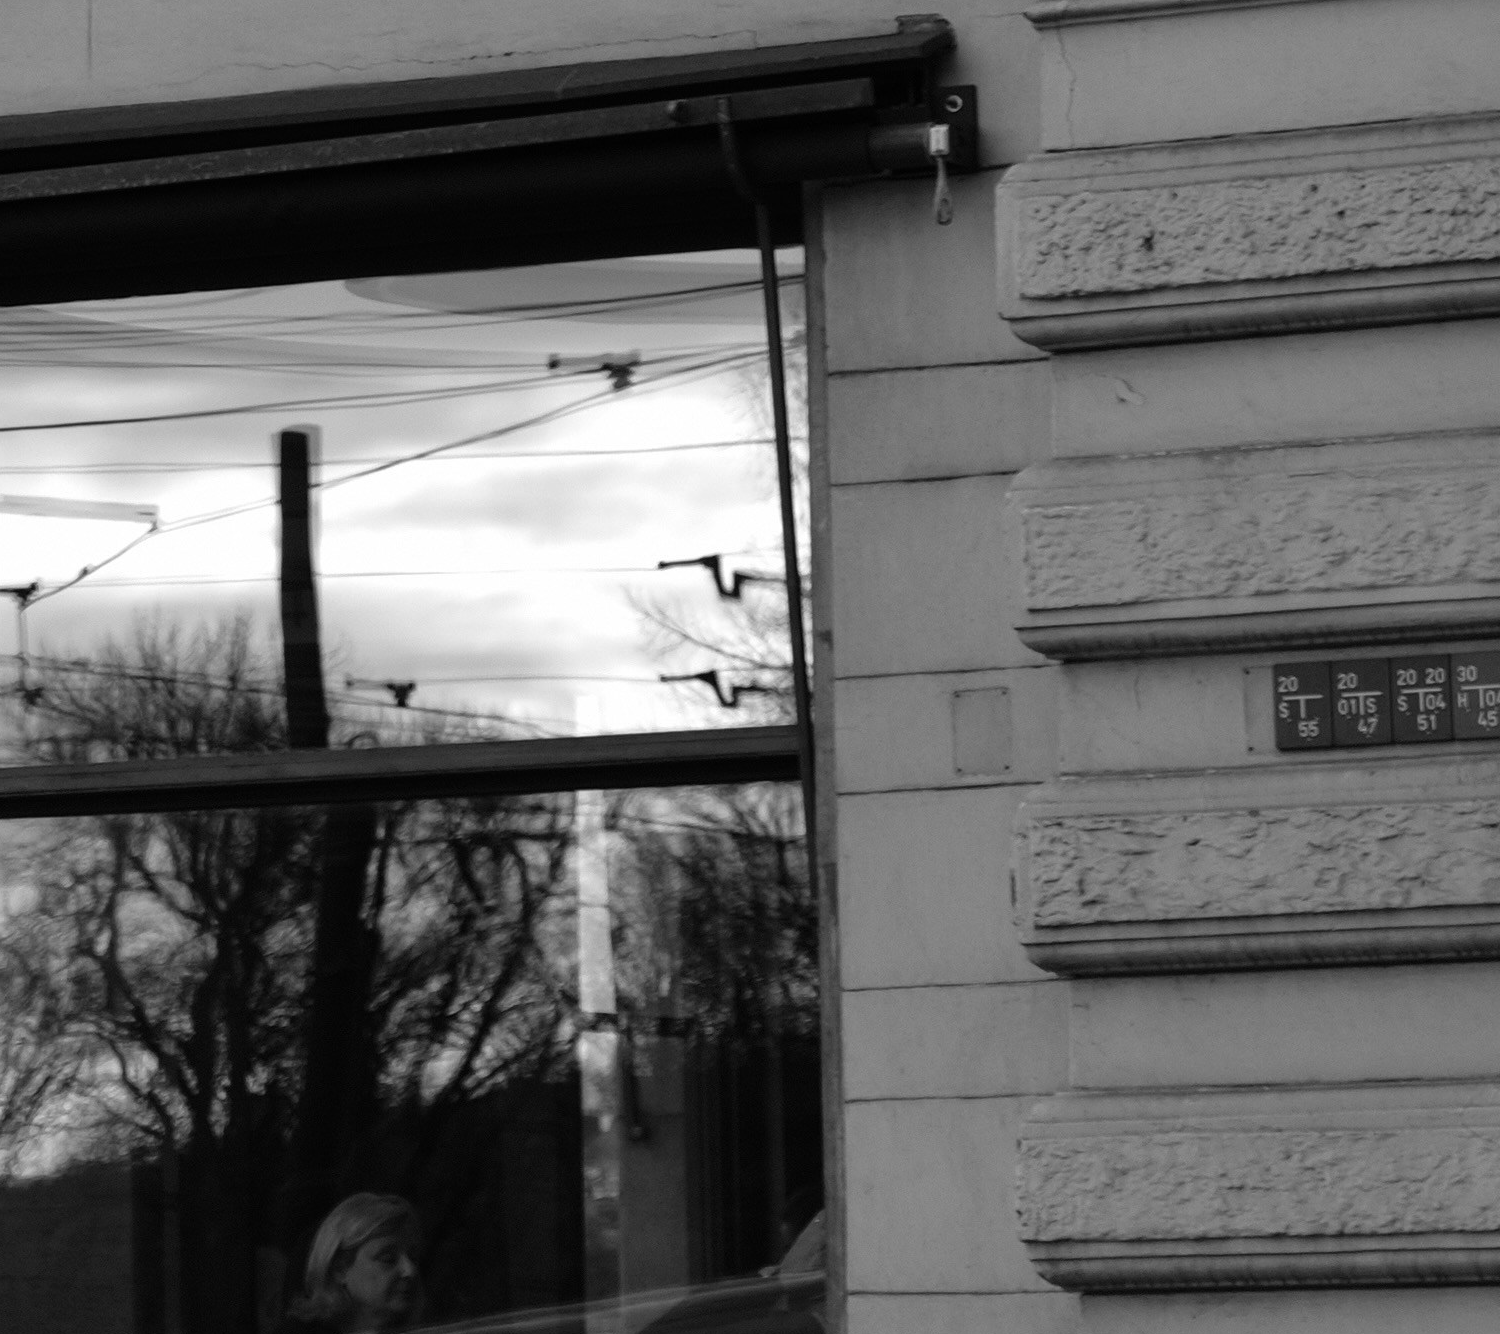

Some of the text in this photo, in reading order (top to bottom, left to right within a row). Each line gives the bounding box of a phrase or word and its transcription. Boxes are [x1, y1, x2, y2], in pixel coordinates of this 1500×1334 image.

[1337, 672, 1358, 690] 20
[1396, 667, 1445, 686] 20 20
[1456, 665, 1478, 682] 30
[1278, 676, 1299, 693] 20
[1357, 717, 1379, 734] 47
[1417, 714, 1438, 731] 51
[1478, 710, 1499, 727] 45
[1298, 720, 1319, 738] 55
